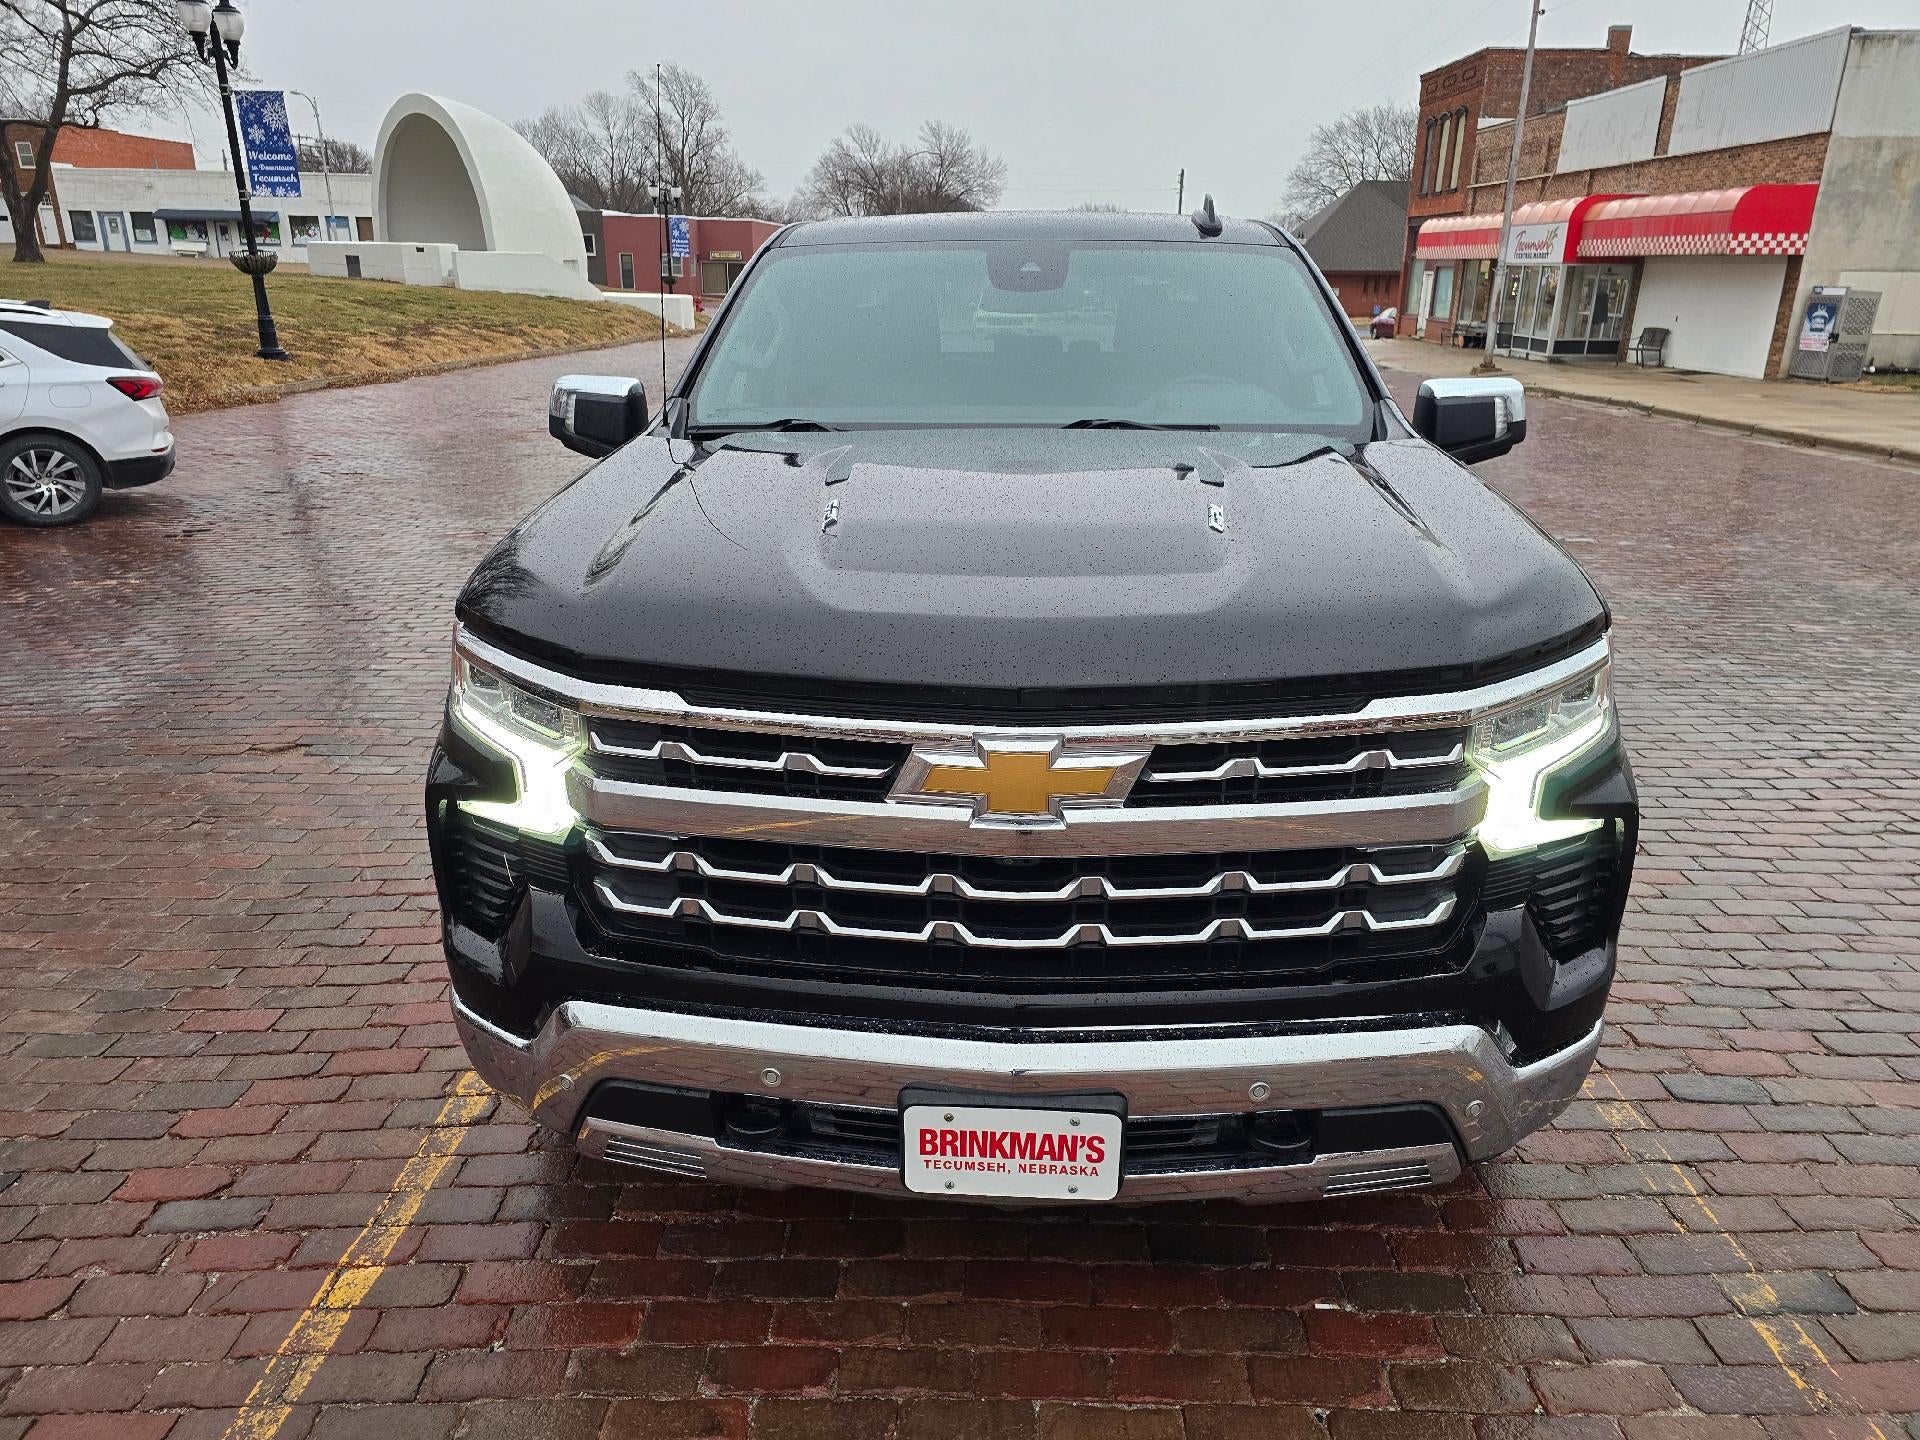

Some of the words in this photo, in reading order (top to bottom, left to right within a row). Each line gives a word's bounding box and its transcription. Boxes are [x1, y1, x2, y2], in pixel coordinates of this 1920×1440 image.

[248, 150, 293, 160] Welcome
[252, 173, 298, 182] Tecumseh
[919, 1128, 1106, 1164] BRINKMAN'S
[924, 1159, 1011, 1175] TECUMSEH,
[1018, 1163, 1100, 1177] NEBRASKA
